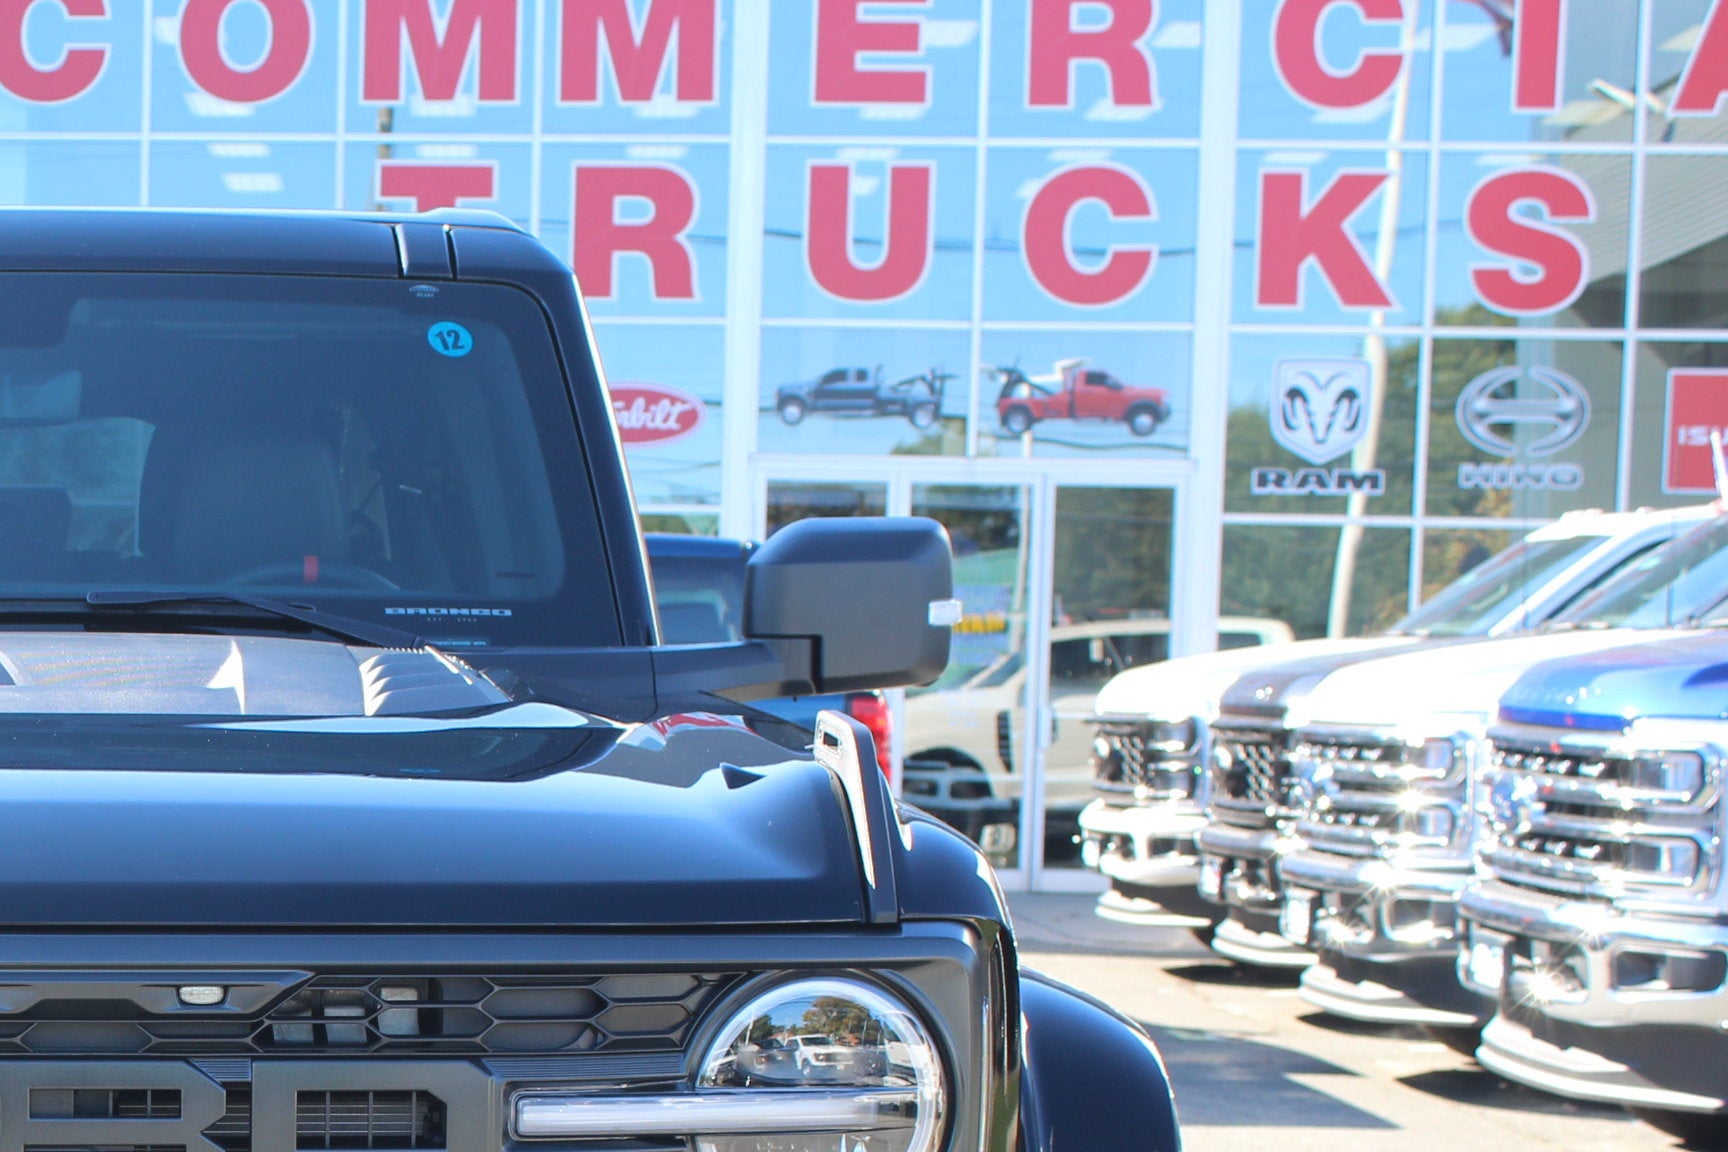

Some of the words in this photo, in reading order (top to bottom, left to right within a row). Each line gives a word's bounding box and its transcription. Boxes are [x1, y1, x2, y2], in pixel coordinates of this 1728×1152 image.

[378, 161, 1596, 316] TRUCKS
[435, 329, 465, 351] 12
[1253, 469, 1385, 494] RAM
[1459, 463, 1583, 490] HINO
[385, 607, 513, 617] BRONCO
